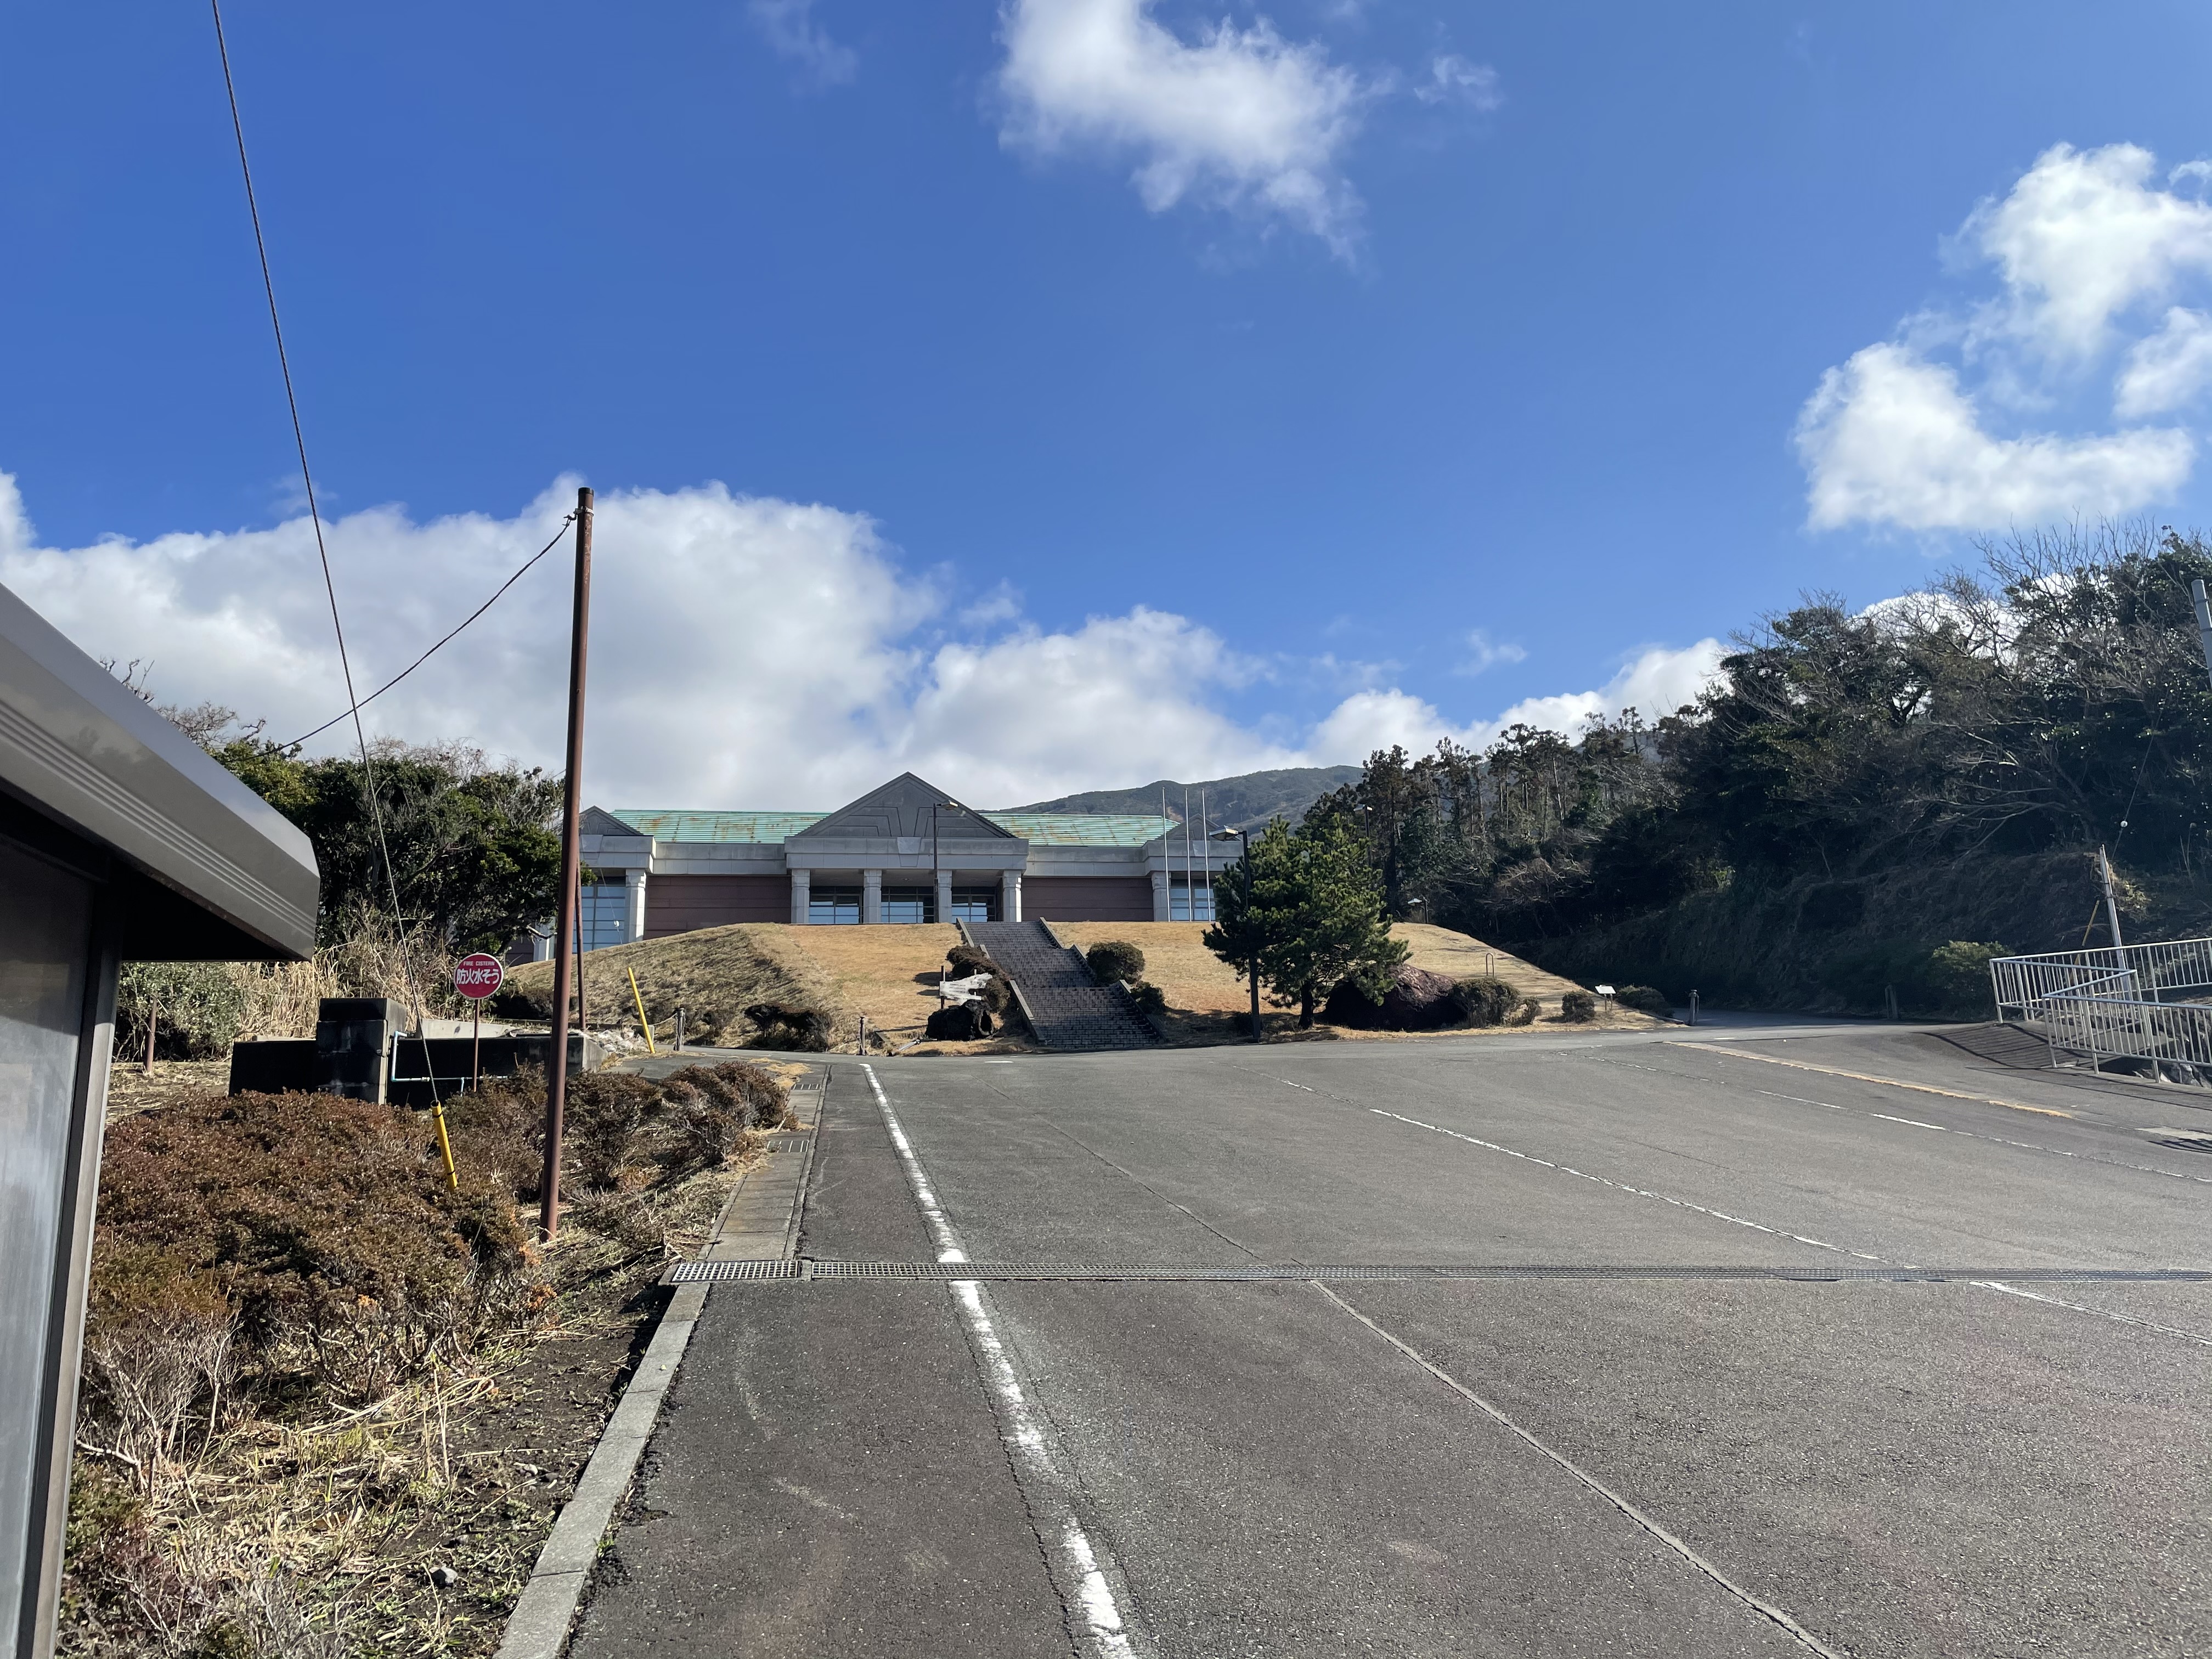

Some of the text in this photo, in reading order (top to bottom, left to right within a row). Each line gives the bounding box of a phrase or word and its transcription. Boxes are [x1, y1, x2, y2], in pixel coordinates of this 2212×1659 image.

[456, 968, 500, 985] 防火水そう
